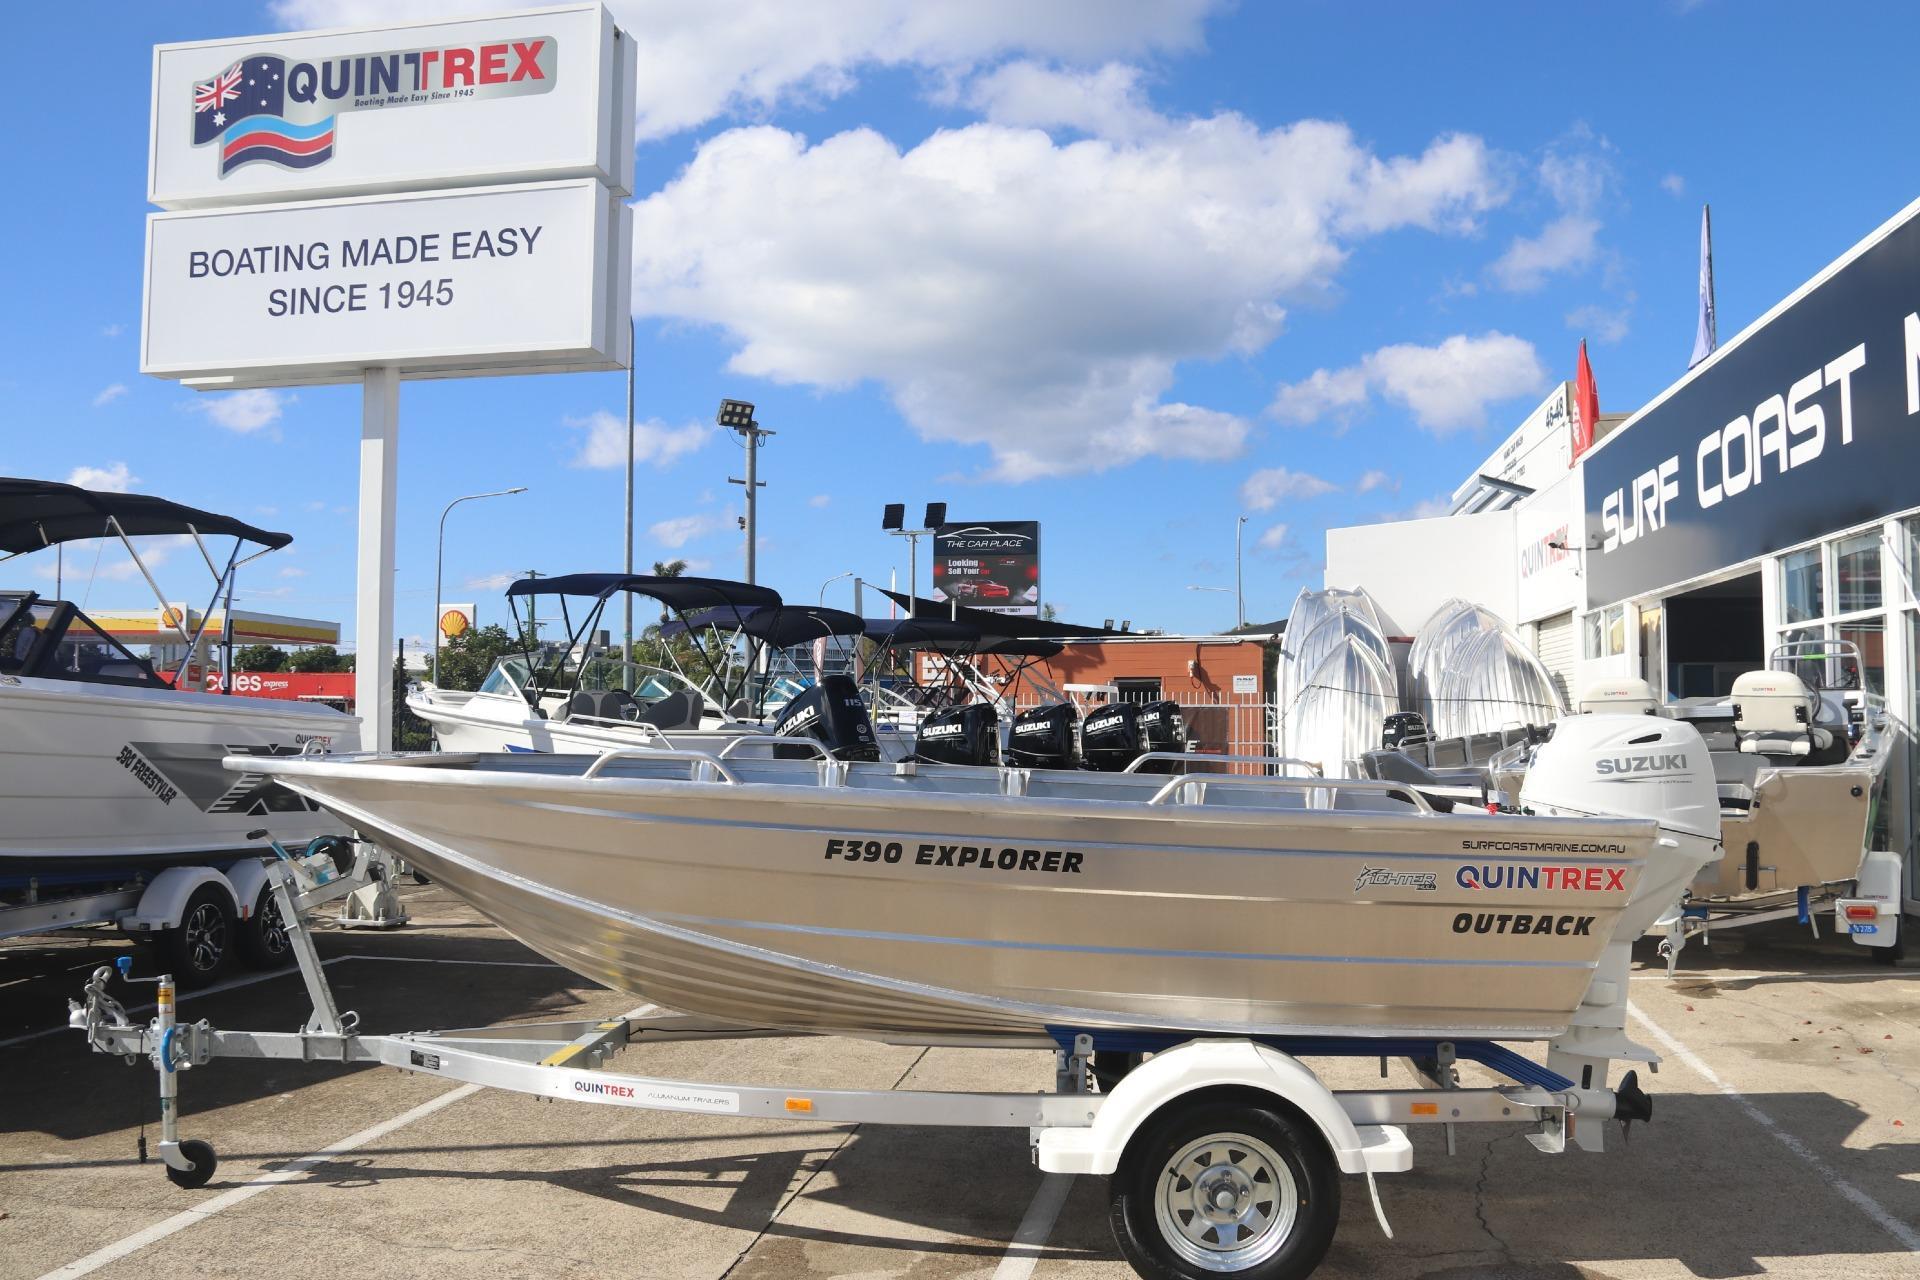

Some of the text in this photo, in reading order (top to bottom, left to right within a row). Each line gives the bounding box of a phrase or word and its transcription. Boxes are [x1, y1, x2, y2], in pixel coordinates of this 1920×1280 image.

[288, 40, 545, 104] QUINTREX
[354, 88, 474, 107] Boating Made Easy Since 1945
[189, 226, 542, 278] BOATING MADE EASY
[268, 278, 454, 317] SINCE 1945
[1602, 455, 1679, 554] SURF
[1697, 342, 1866, 509] COAST
[946, 540, 966, 548] THE
[948, 559, 978, 567] Looking
[263, 680, 289, 689] express
[775, 705, 815, 737] SUZUKI
[1015, 721, 1050, 734] SUZUKI
[1086, 715, 1123, 732] SUZUKI
[1144, 711, 1160, 722] UKI
[923, 724, 962, 737] SUZUKI
[1595, 754, 1687, 774] SUZUKI
[116, 745, 177, 806] 590 FREESTYLER
[824, 839, 1084, 873] F390 EXPLORER
[1462, 840, 1626, 854] SURFCOASTMARINE.COM.AU
[1456, 865, 1627, 891] QUINTREX
[1452, 912, 1596, 936] OUTBACK
[574, 1081, 634, 1098] QUINTREX
[693, 1096, 730, 1105] TRAILERS
